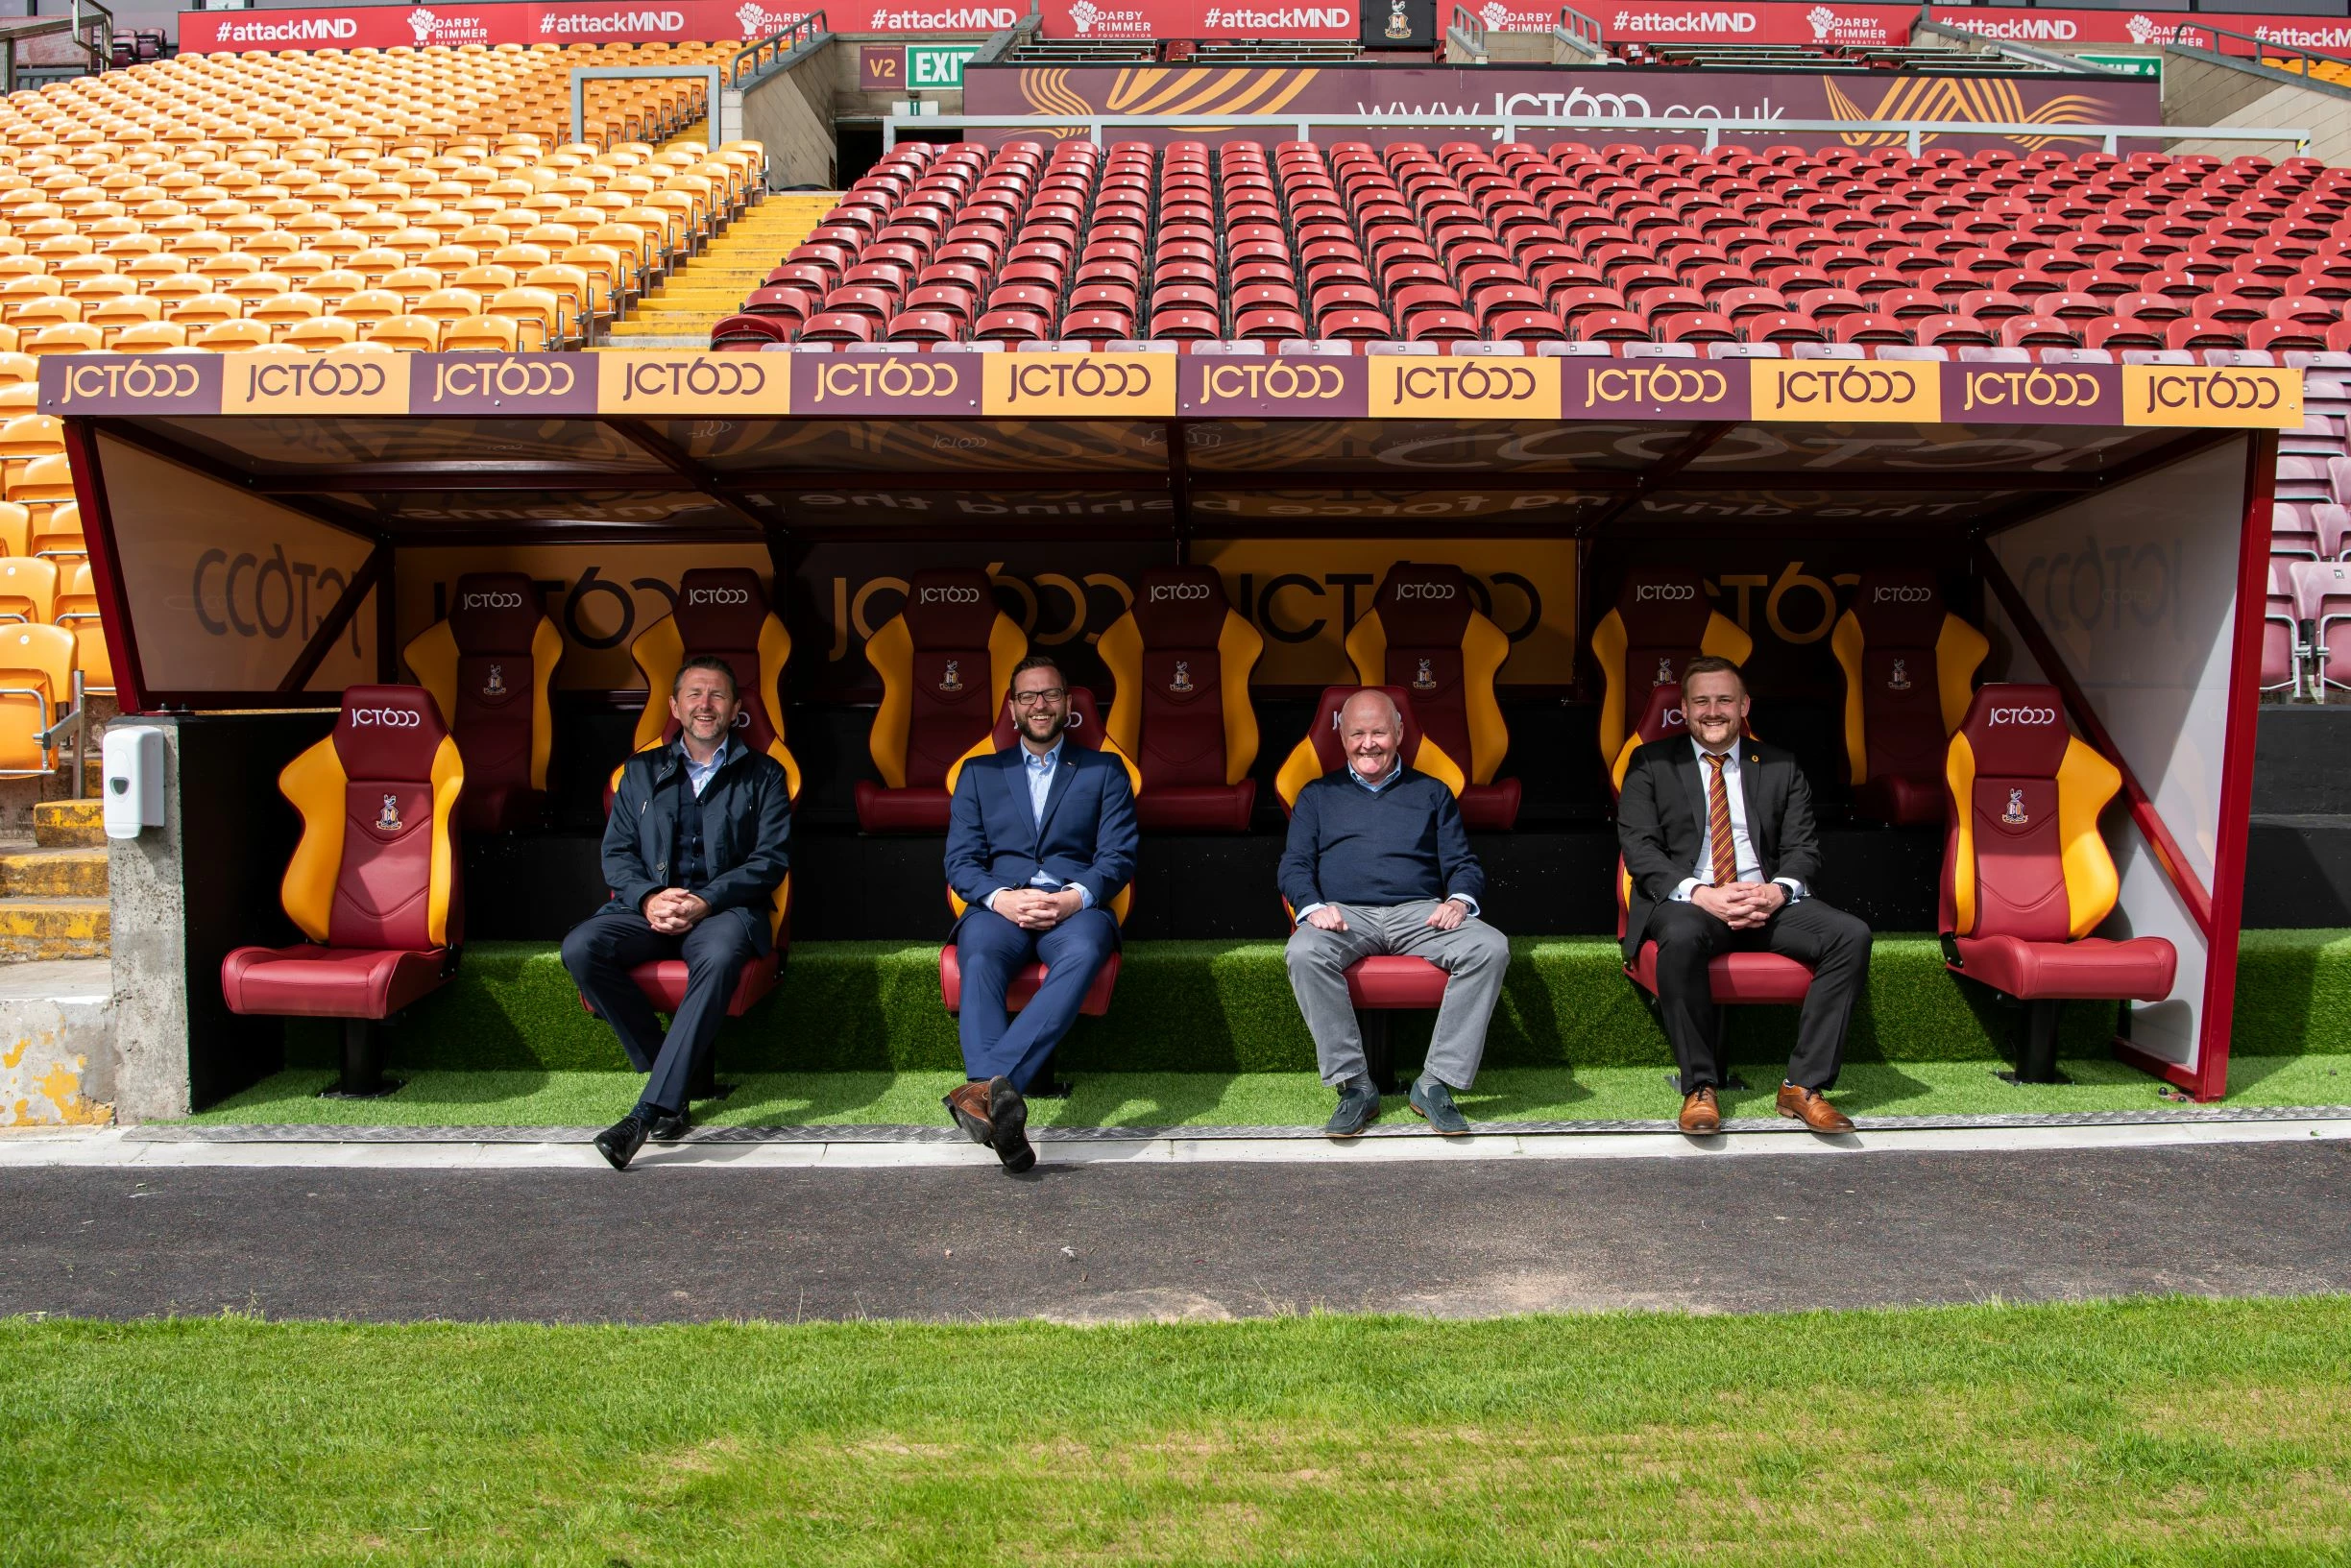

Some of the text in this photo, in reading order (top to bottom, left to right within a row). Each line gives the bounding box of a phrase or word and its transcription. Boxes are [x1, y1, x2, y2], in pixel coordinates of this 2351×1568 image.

[436, 18, 479, 28] DARBY
[540, 12, 684, 34] #attackMND
[871, 9, 1016, 29] #attackMND
[1099, 12, 1143, 20] DARBY
[1204, 9, 1349, 28] #attackMND
[1509, 13, 1552, 22] DARBY
[1614, 12, 1757, 32] #attackMND
[1835, 18, 1878, 27] DARBY
[216, 18, 356, 41] #attackMND
[436, 29, 487, 38] RIMMER
[1099, 22, 1151, 31] RIMMER
[1835, 29, 1886, 38] RIMMER
[869, 59, 896, 78] V2
[62, 358, 199, 403] JCT600
[247, 358, 384, 402] JCT600
[433, 357, 574, 402] JCT600
[623, 357, 765, 401] JCT600
[814, 357, 958, 402] JCT600
[1008, 357, 1151, 402] JCT600
[1200, 359, 1344, 404] JCT600
[1394, 361, 1536, 405] JCT600
[1586, 363, 1727, 407] JCT600
[1776, 365, 1915, 409] JCT600
[1964, 367, 2099, 411] JCT600
[2147, 368, 2280, 413] JCT600
[463, 590, 521, 611] JCT600
[689, 588, 748, 607] JCT600
[920, 586, 980, 604] JCT600
[1151, 583, 1210, 602] JCT600
[1395, 582, 1456, 601] JCT600
[1636, 583, 1695, 602] JCT600
[1873, 584, 1931, 604] JCT600
[351, 707, 421, 728] JCT600
[1988, 706, 2055, 727] JCT600
